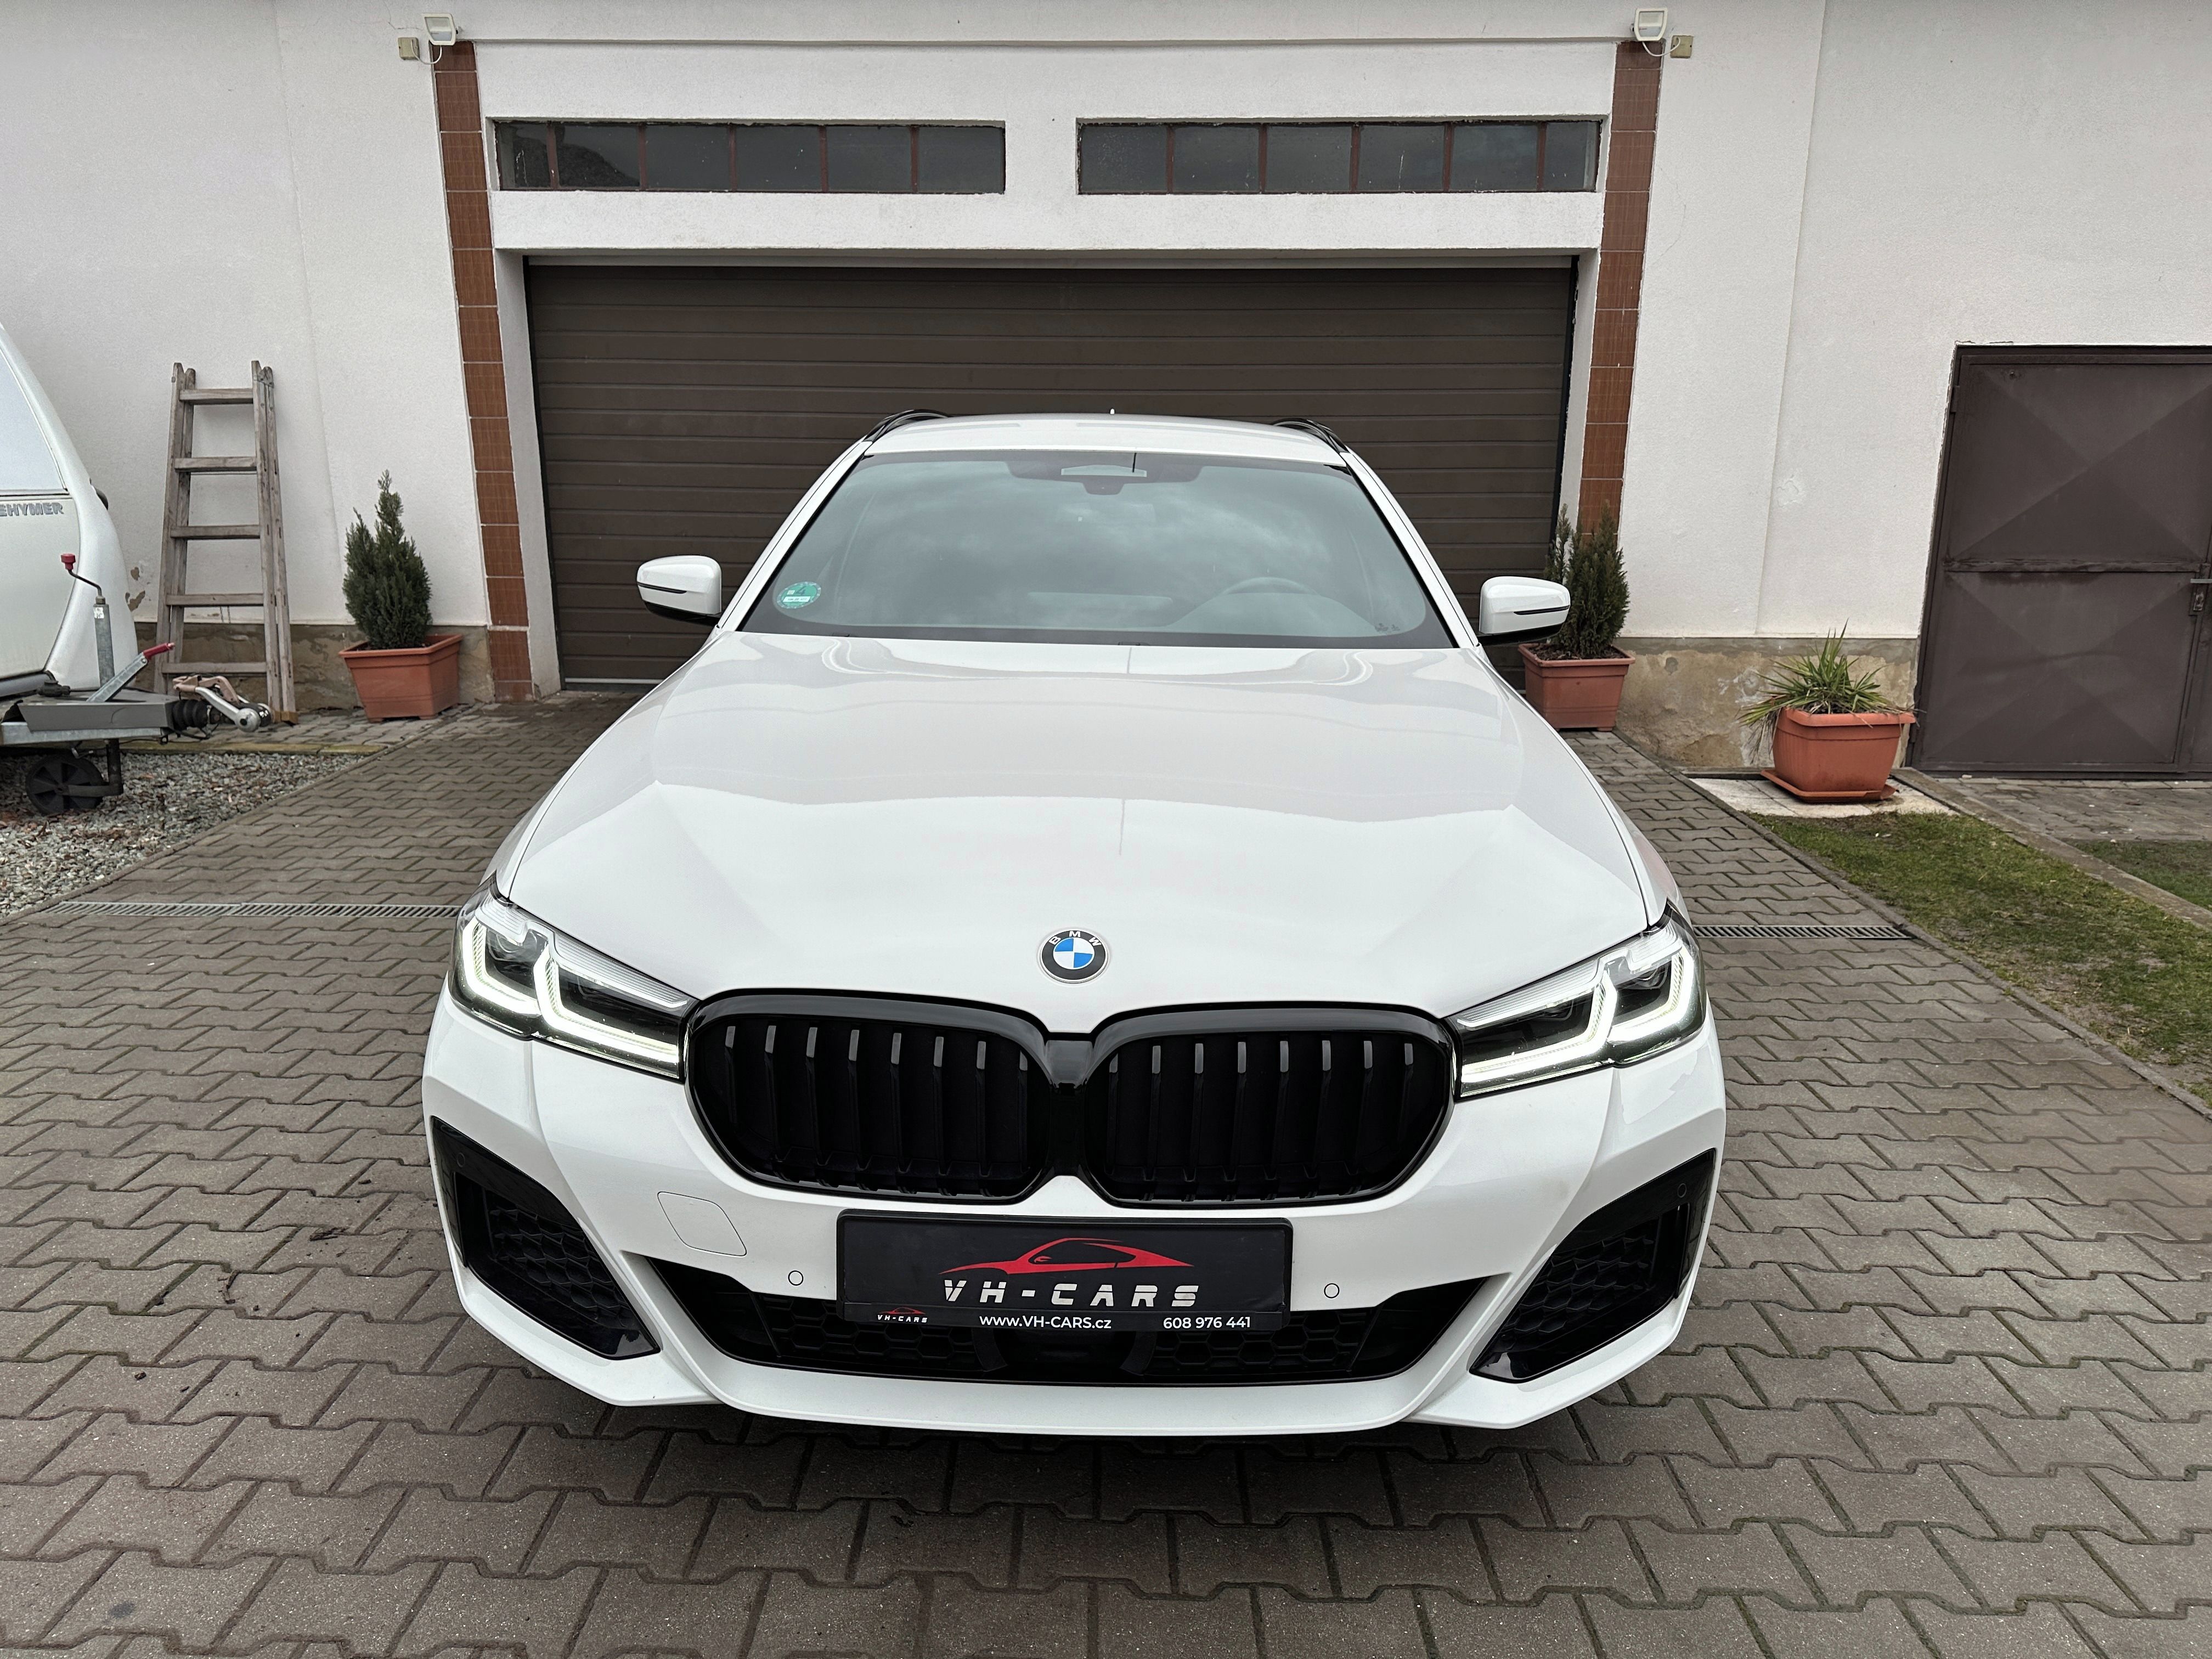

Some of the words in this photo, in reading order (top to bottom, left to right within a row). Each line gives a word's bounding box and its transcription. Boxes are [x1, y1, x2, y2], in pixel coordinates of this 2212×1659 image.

[1048, 930, 1102, 946] BMW
[944, 1279, 1199, 1307] VH-CARS
[877, 1314, 928, 1323] VH-CARS
[979, 1315, 1112, 1329] www.VH-CARS.cz
[1163, 1317, 1192, 1329] 608
[1195, 1317, 1222, 1328] 976
[1226, 1316, 1250, 1328] 441
